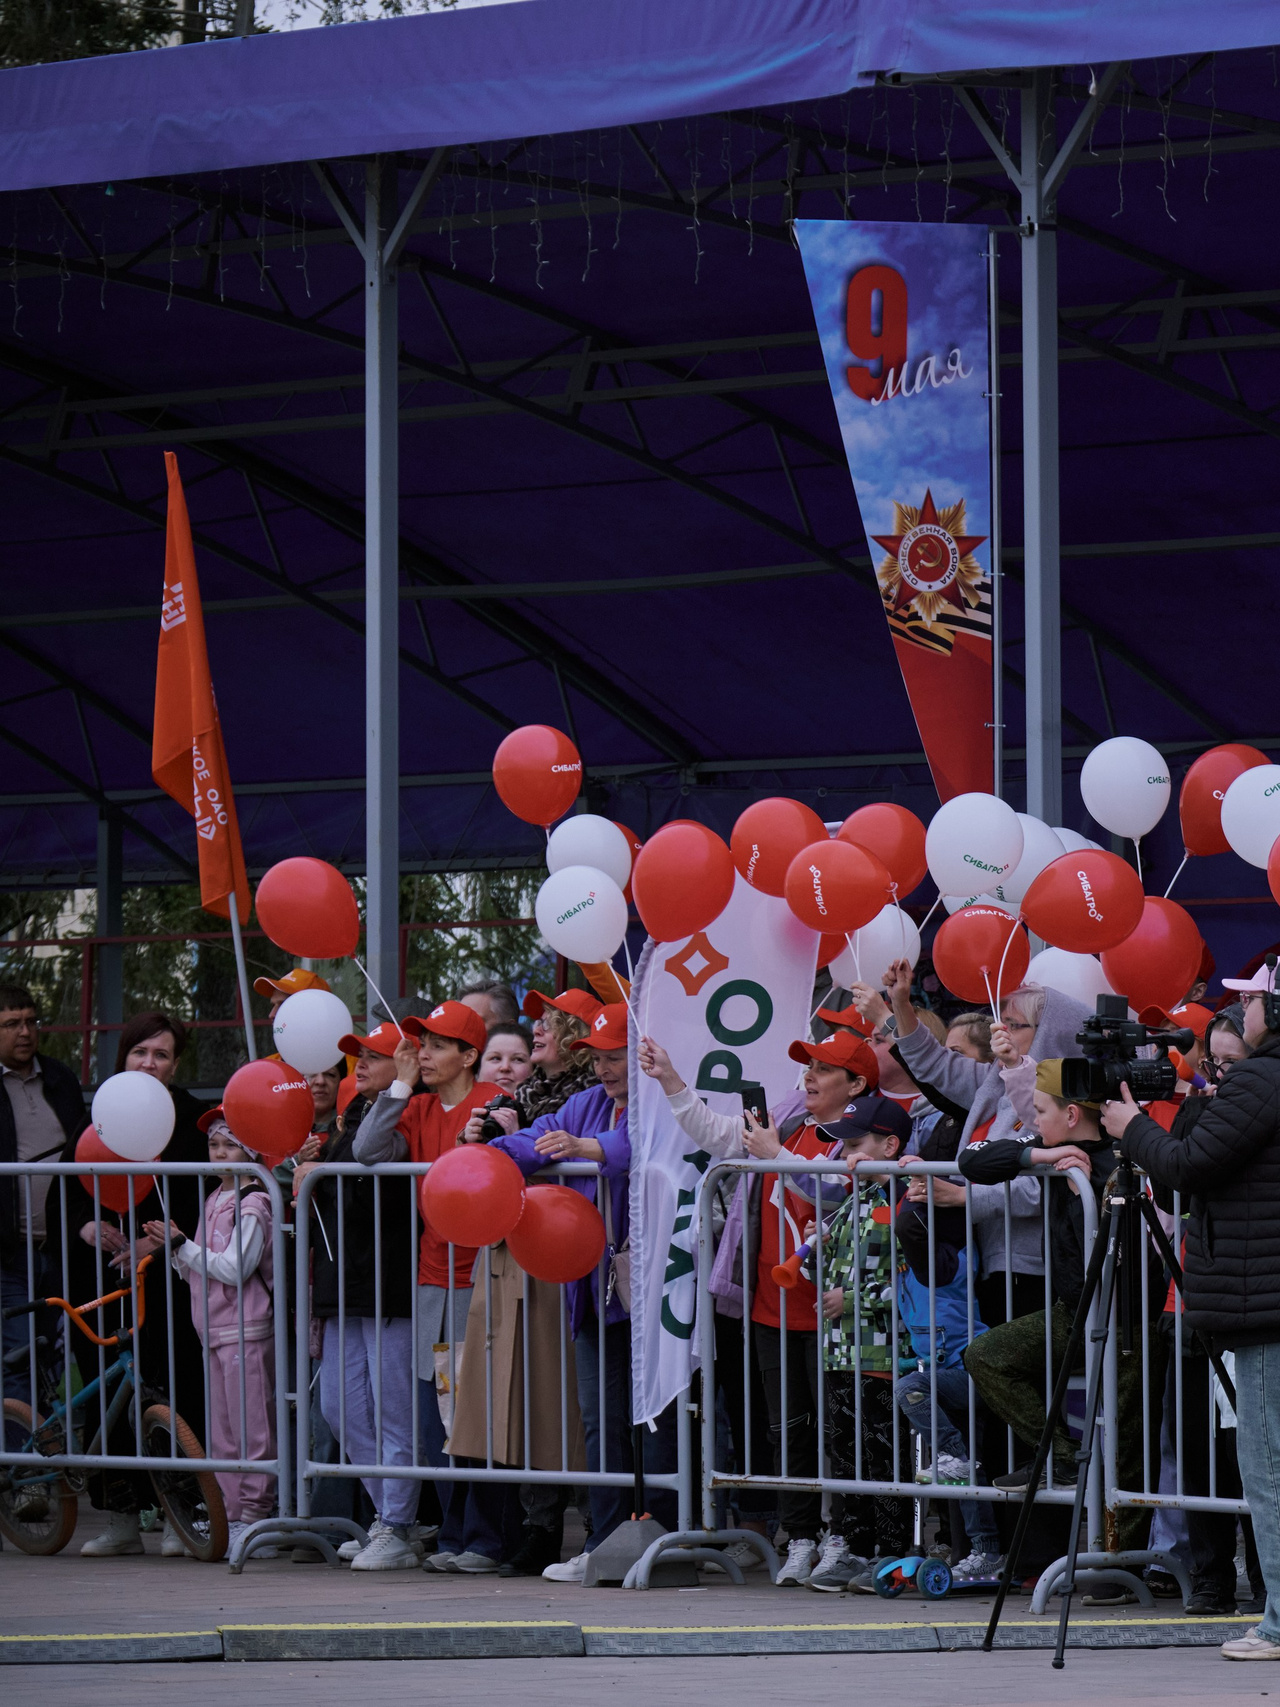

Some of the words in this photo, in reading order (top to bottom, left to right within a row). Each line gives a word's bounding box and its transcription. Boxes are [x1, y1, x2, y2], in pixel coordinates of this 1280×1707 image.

[846, 265, 908, 401] 9
[870, 347, 974, 407] мая
[901, 526, 953, 586] ОТЕЧЕСТВЕННАЯ
[963, 854, 1004, 875] СИБАГРО
[556, 897, 595, 925] СИБАГРО
[813, 869, 828, 916] СИБАГРО
[1077, 870, 1098, 919] СИБАГРО
